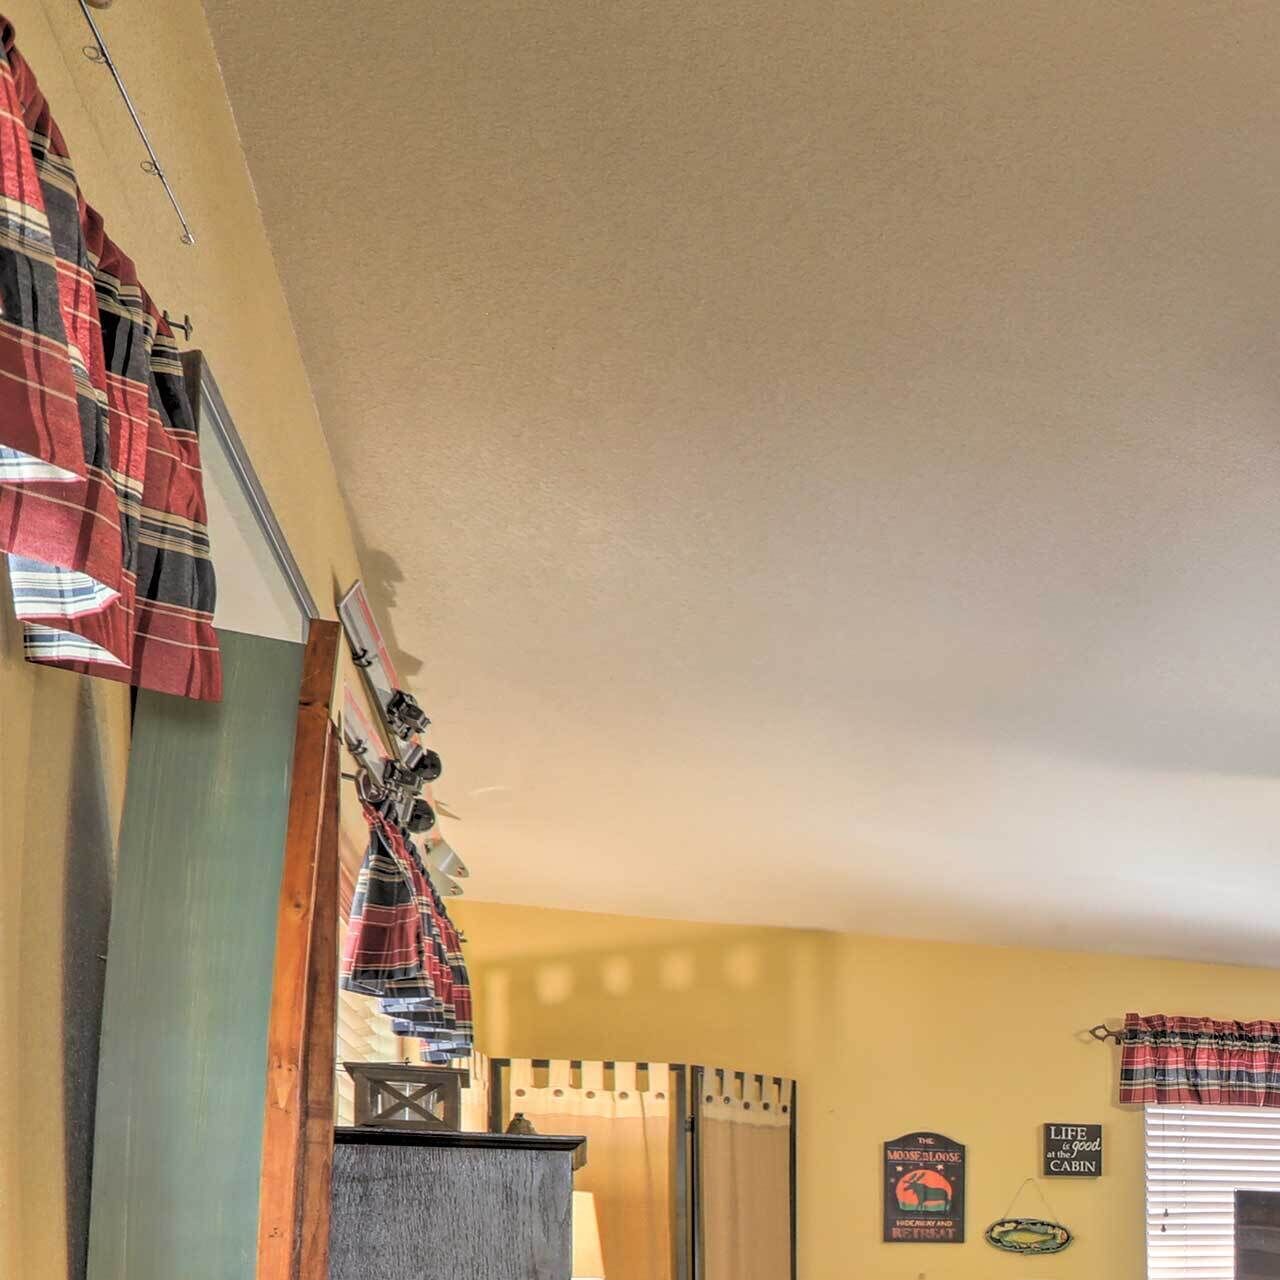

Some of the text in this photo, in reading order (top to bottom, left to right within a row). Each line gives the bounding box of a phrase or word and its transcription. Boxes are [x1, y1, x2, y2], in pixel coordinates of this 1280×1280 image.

[1049, 1126, 1087, 1140] LIFE
[916, 1136, 935, 1145] THE
[1062, 1137, 1101, 1158] is good
[887, 1150, 921, 1160] MOOSE
[928, 1151, 962, 1162] LOOSE
[1057, 1150, 1071, 1158] the
[1049, 1160, 1096, 1172] CABIN
[891, 1227, 956, 1240] RETREAT
